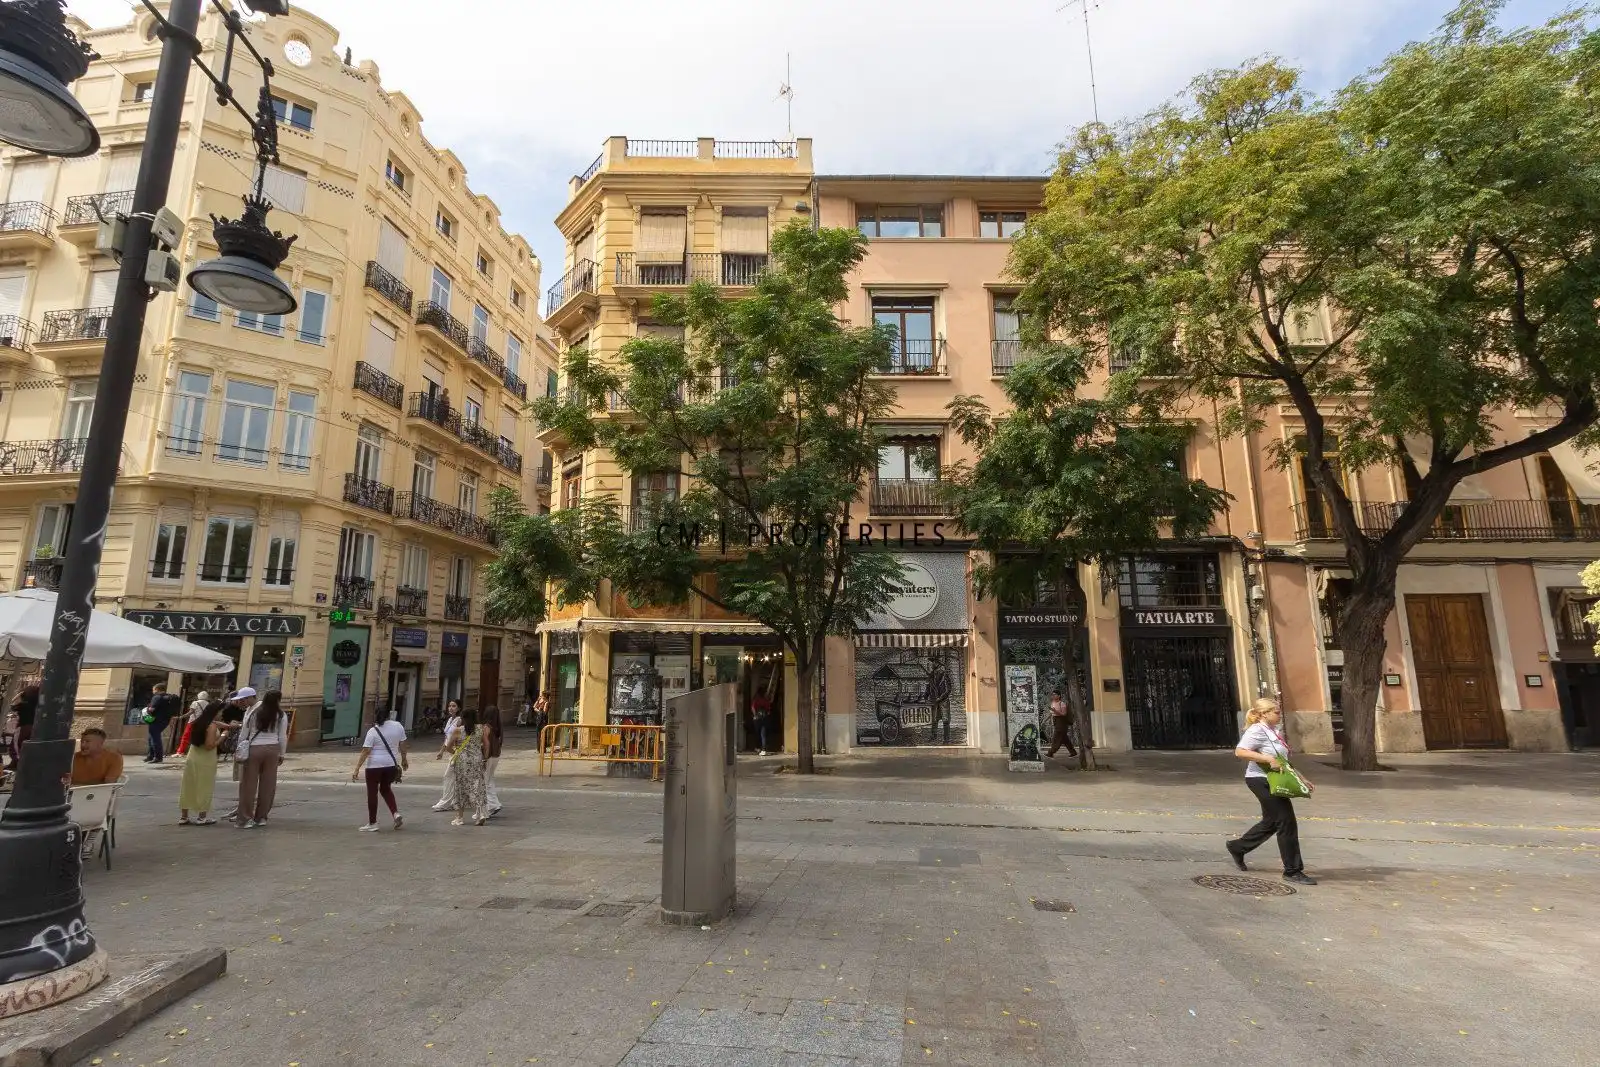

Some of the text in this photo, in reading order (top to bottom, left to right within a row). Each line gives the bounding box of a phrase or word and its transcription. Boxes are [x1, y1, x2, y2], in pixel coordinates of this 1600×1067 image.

[139, 614, 291, 633] FARMACIA
[1004, 614, 1078, 623] TATTOO STUDIO
[1135, 612, 1215, 624] TATUARTE
[66, 830, 75, 843] 5
